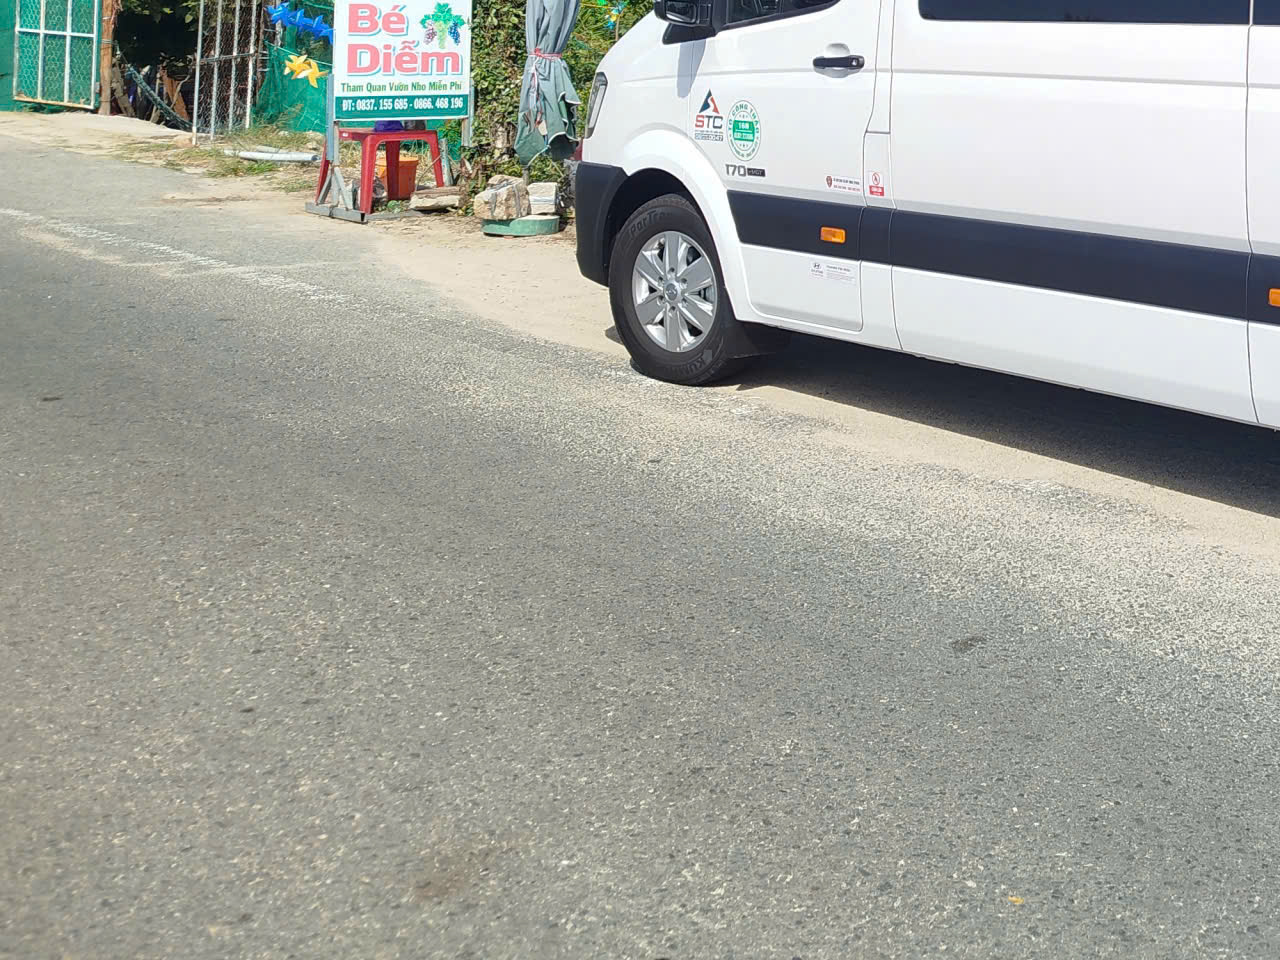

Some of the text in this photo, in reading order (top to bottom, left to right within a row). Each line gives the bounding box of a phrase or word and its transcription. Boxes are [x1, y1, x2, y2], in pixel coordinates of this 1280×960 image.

[348, 3, 408, 36] Bé
[346, 40, 464, 76] Diễm
[341, 83, 364, 93] Tham
[366, 83, 387, 93] Quan
[411, 81, 427, 92] Nho
[379, 98, 393, 110] 155
[394, 98, 408, 110] 685
[435, 97, 449, 109] 468
[450, 97, 463, 108] 196
[695, 114, 724, 129] STC
